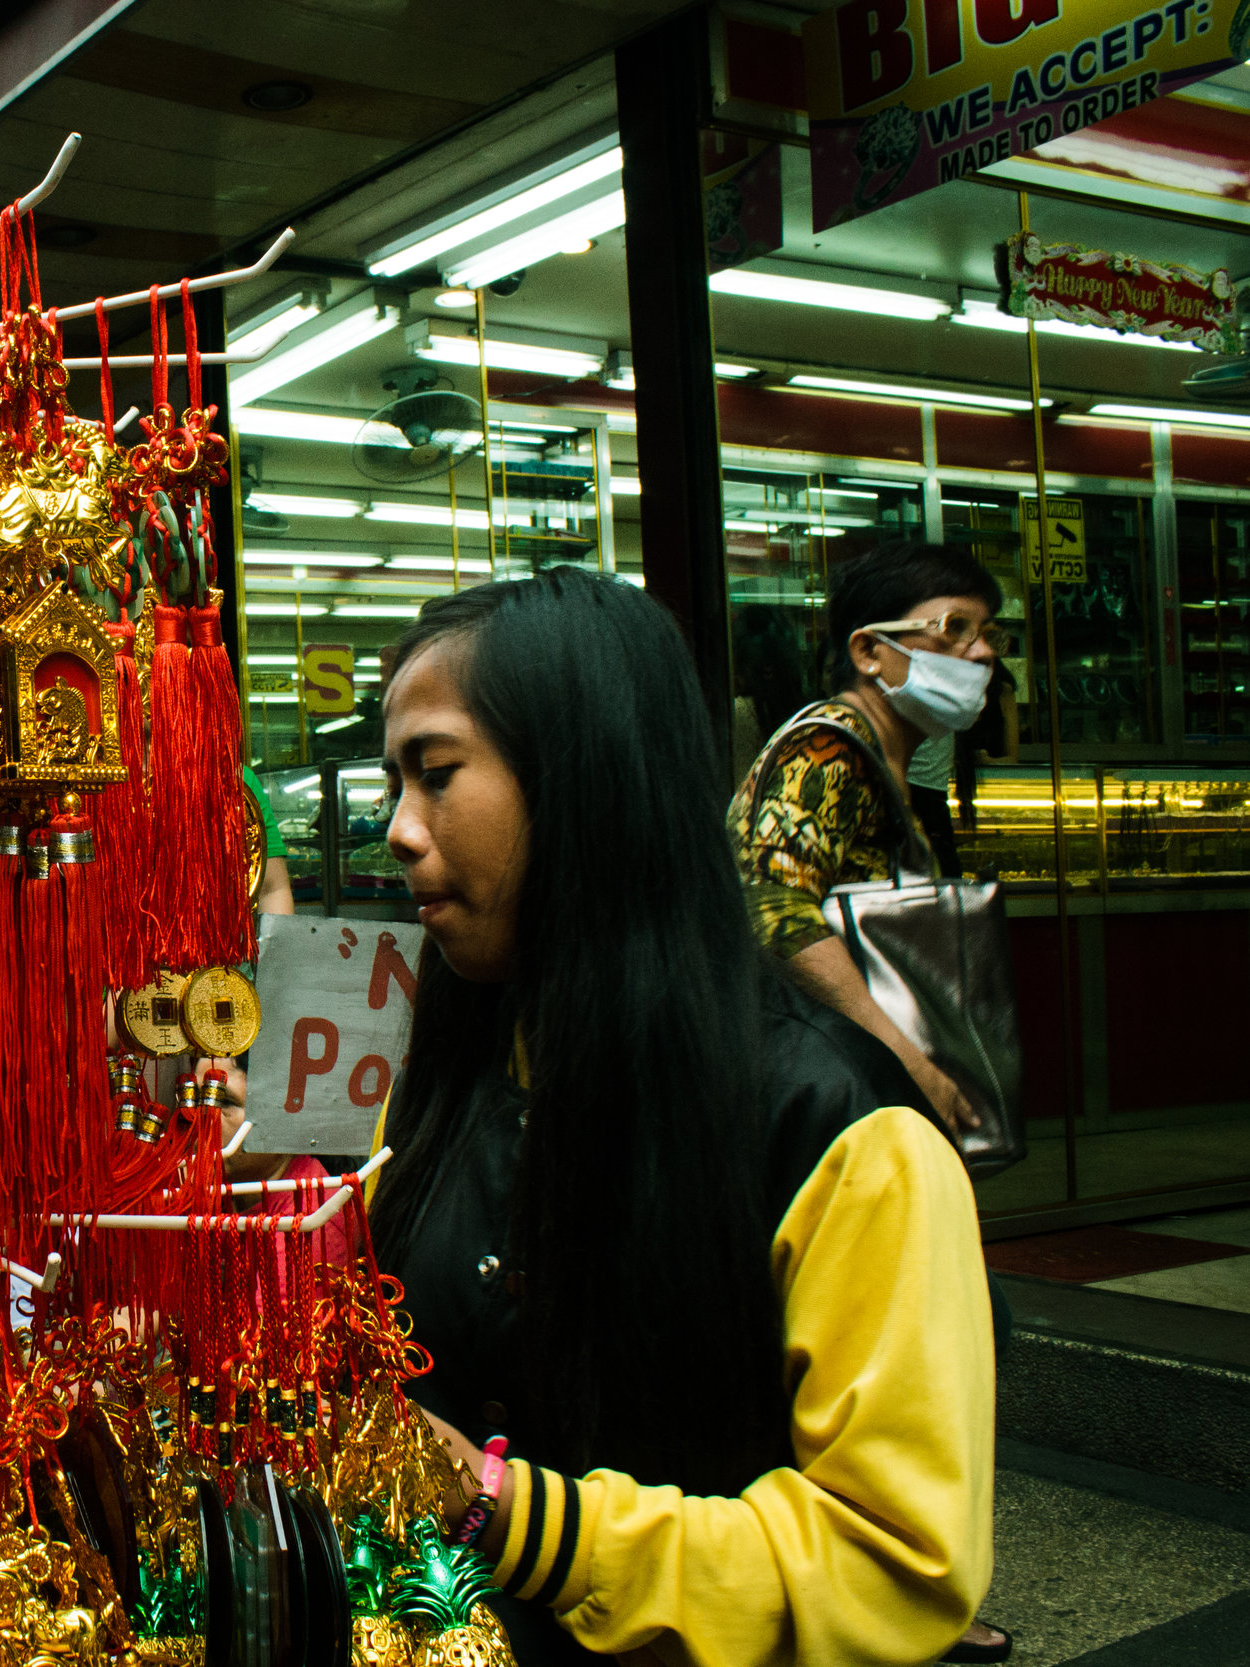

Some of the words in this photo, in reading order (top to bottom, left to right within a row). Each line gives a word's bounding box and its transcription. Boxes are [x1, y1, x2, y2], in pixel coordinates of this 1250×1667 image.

[924, 84, 992, 147] WE
[1005, 0, 1214, 117] ACCEPT:
[938, 129, 1011, 185] MADE
[1018, 111, 1054, 154] TO
[1061, 71, 1160, 133] ORDER
[1042, 263, 1114, 311] Happy
[1116, 277, 1158, 311] New
[1157, 284, 1206, 320] Year
